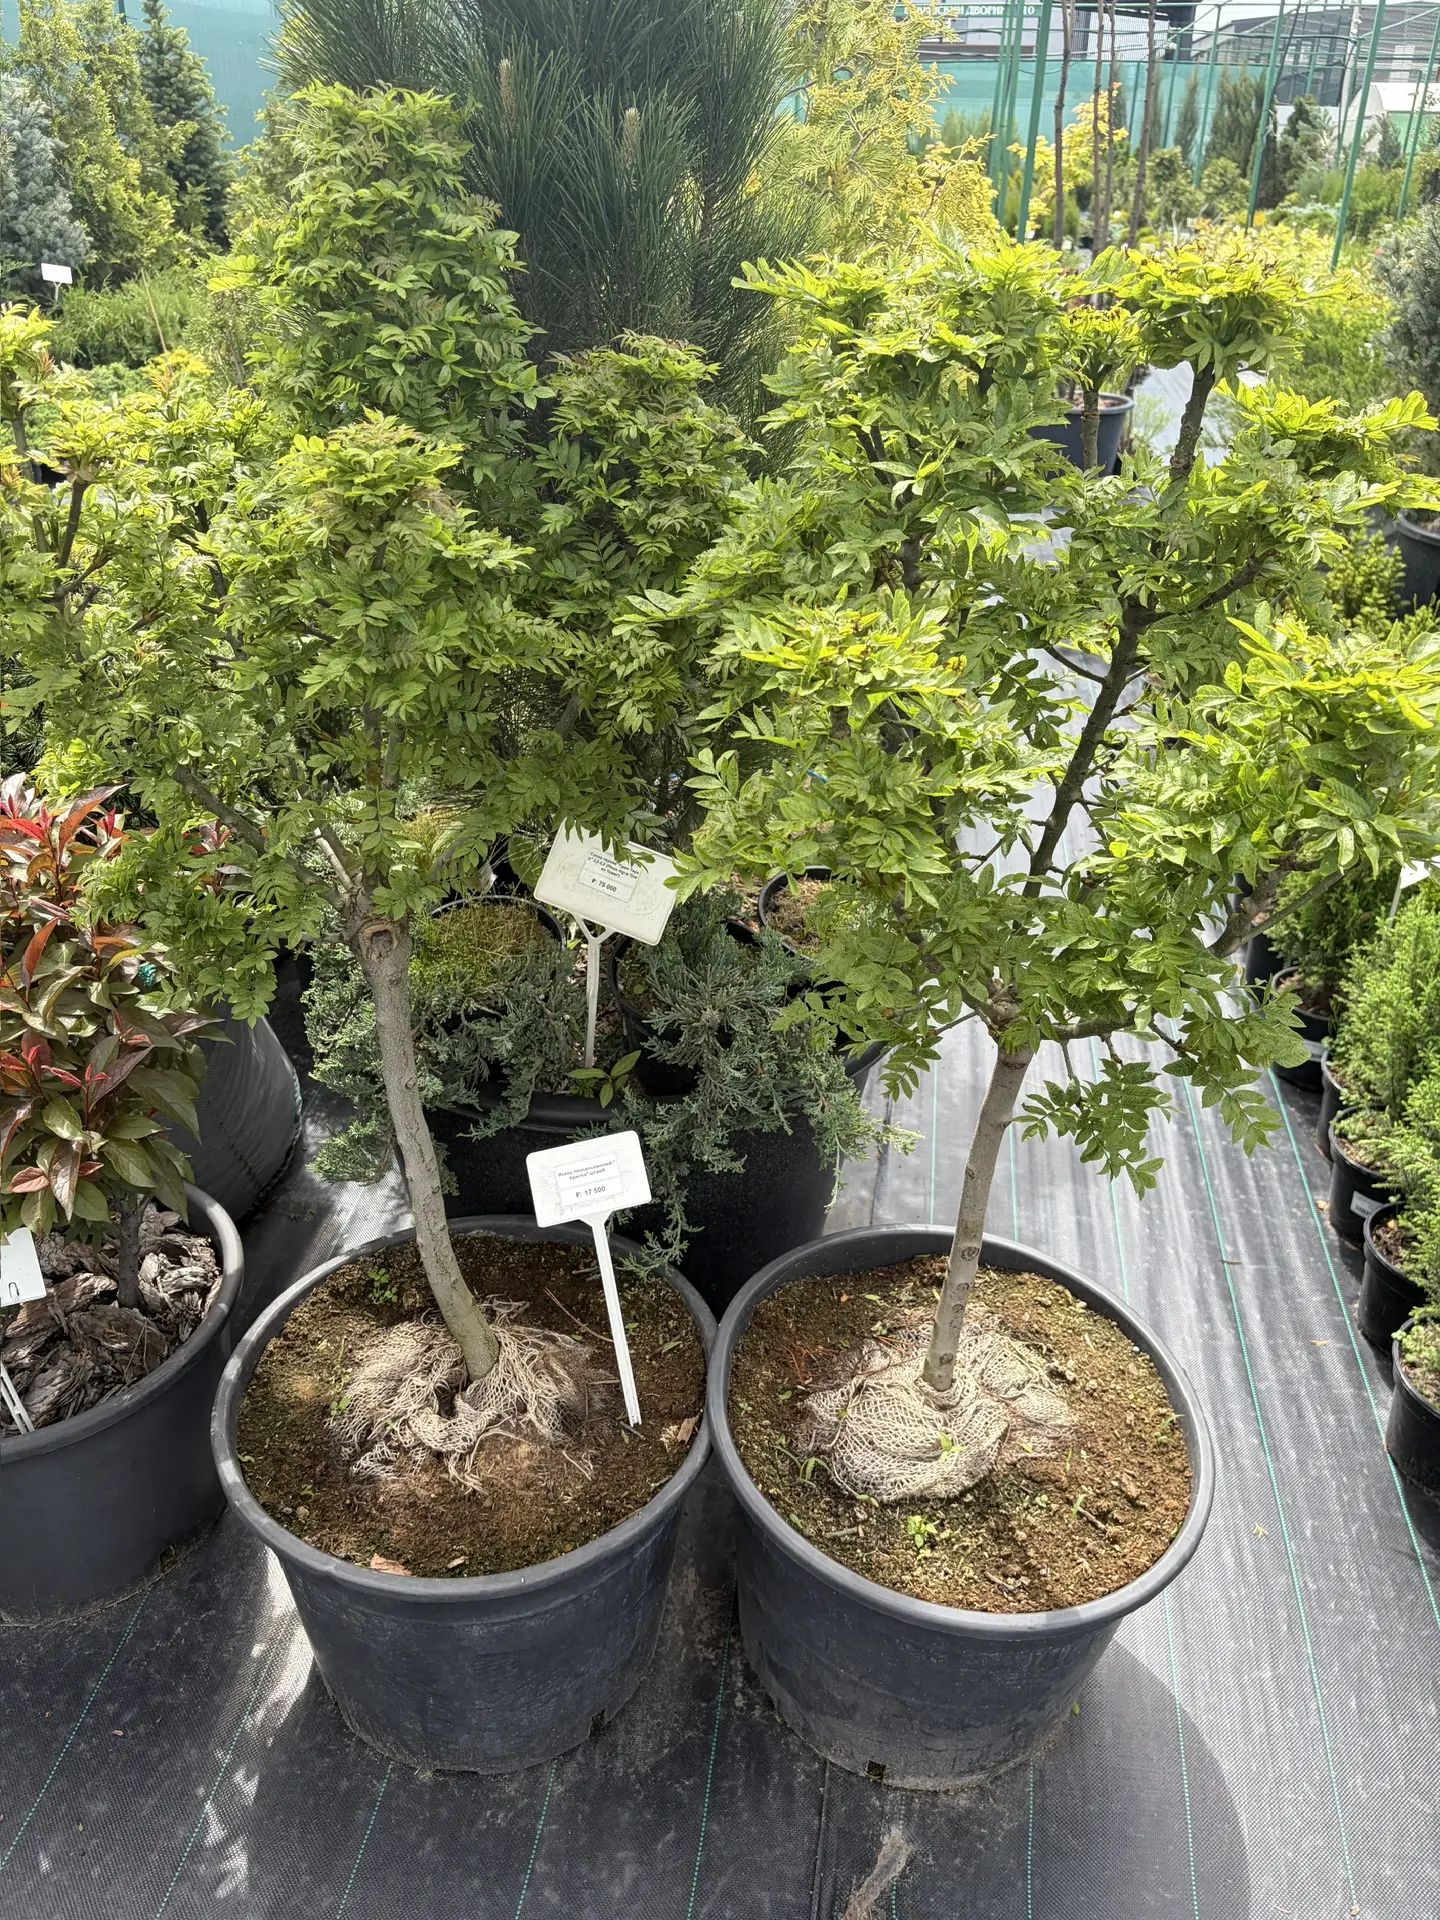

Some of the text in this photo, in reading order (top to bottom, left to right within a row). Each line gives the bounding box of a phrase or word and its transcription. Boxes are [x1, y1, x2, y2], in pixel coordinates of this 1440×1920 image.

[598, 880, 606, 888] 75
[606, 884, 617, 892] 000
[584, 1188, 592, 1196] 17
[593, 1185, 606, 1194] 500
